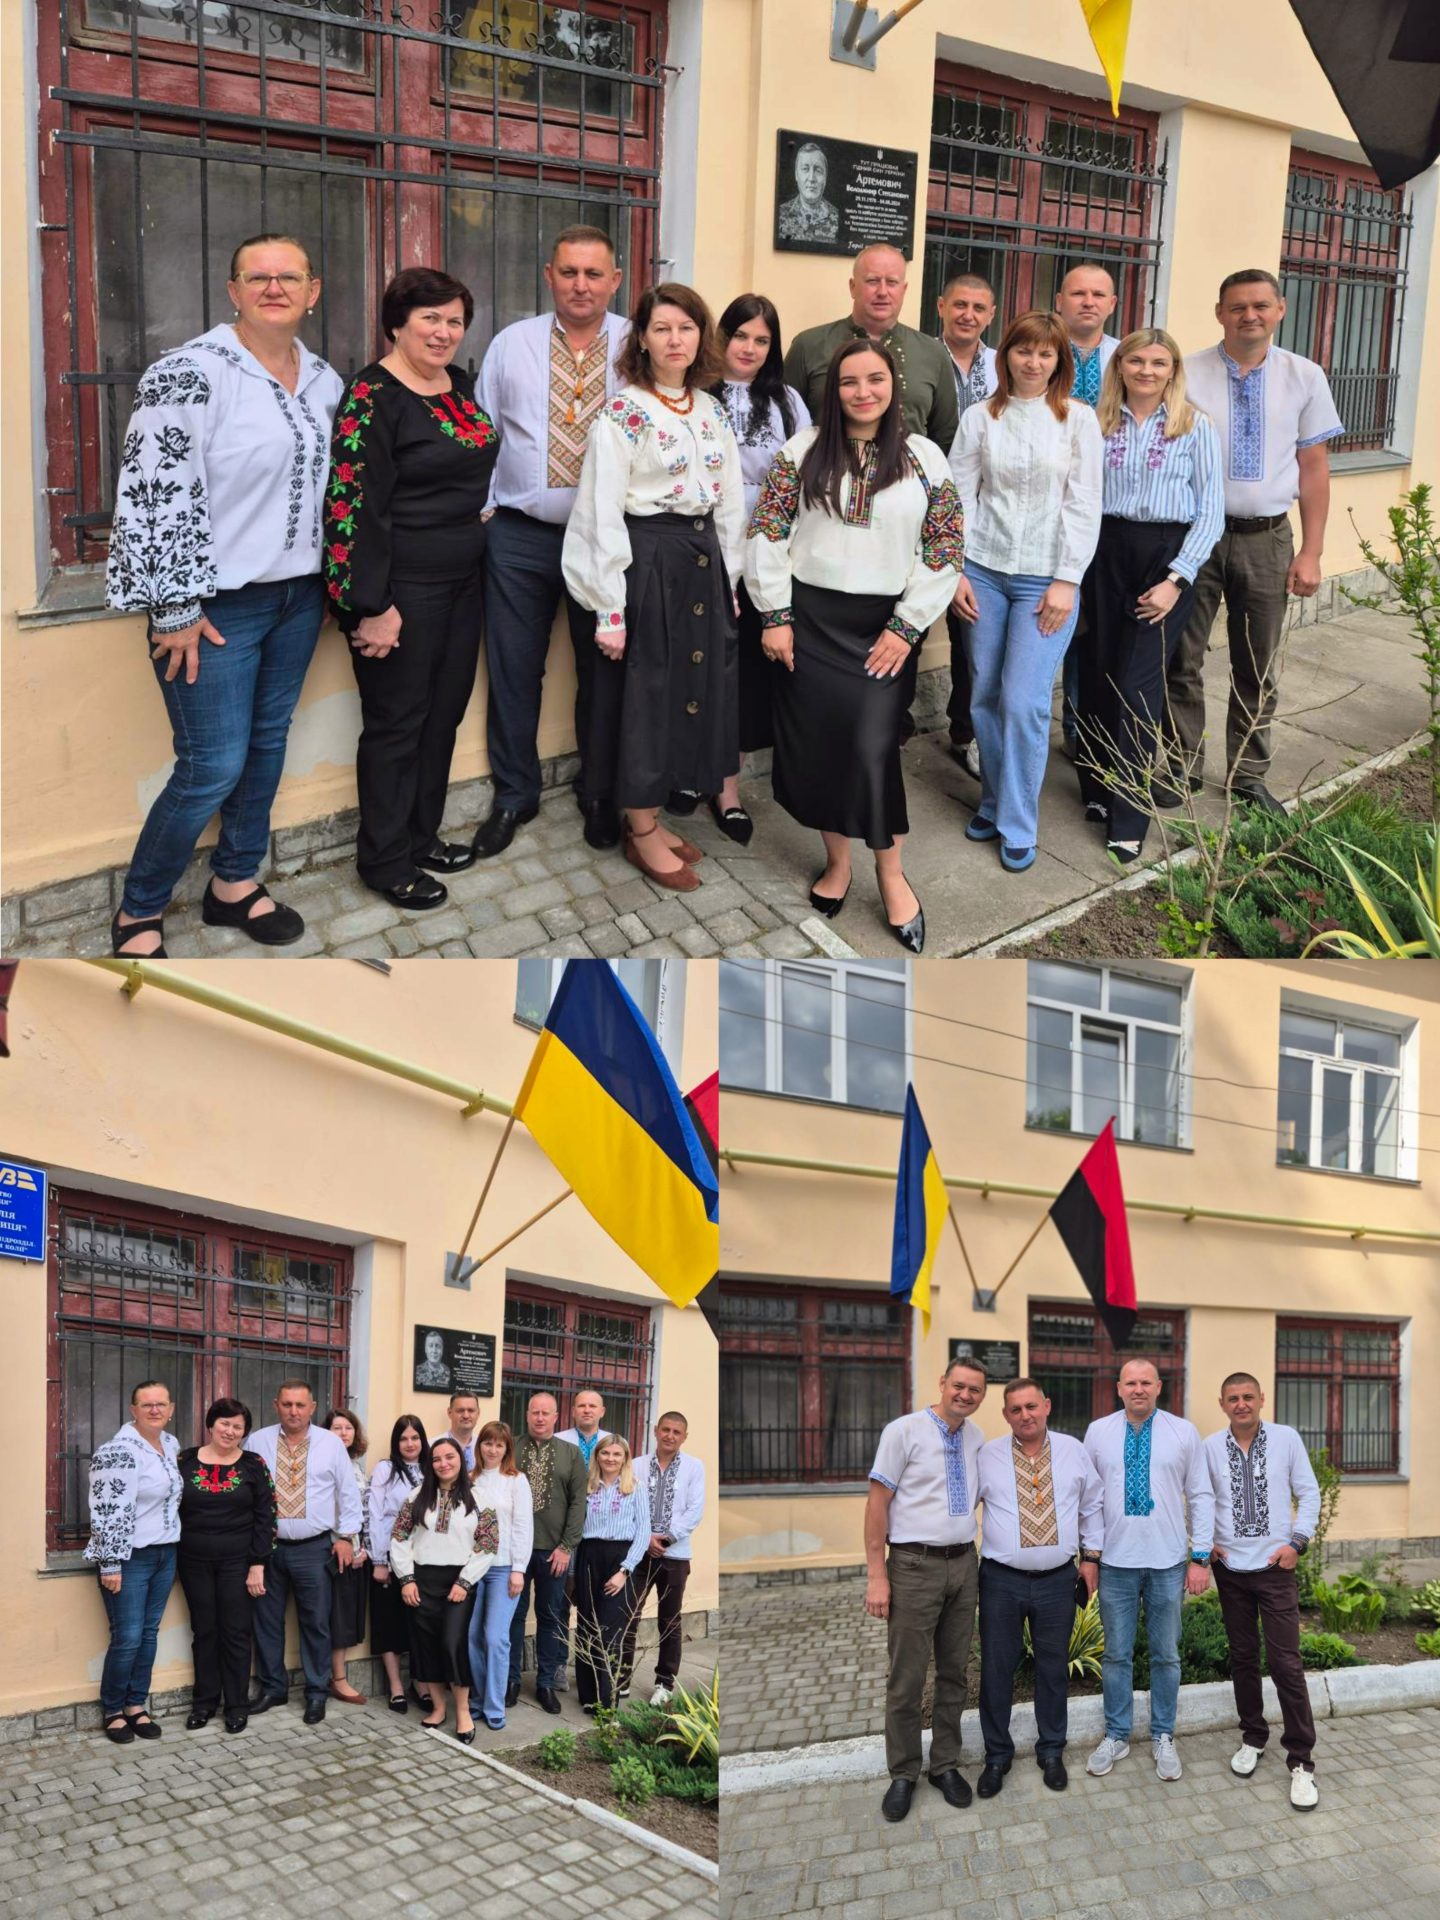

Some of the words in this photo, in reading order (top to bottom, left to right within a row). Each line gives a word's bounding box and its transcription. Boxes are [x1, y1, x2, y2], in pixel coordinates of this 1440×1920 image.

[856, 173, 901, 188] Артемович
[846, 184, 877, 195] Володимир
[878, 189, 909, 199] Степанович
